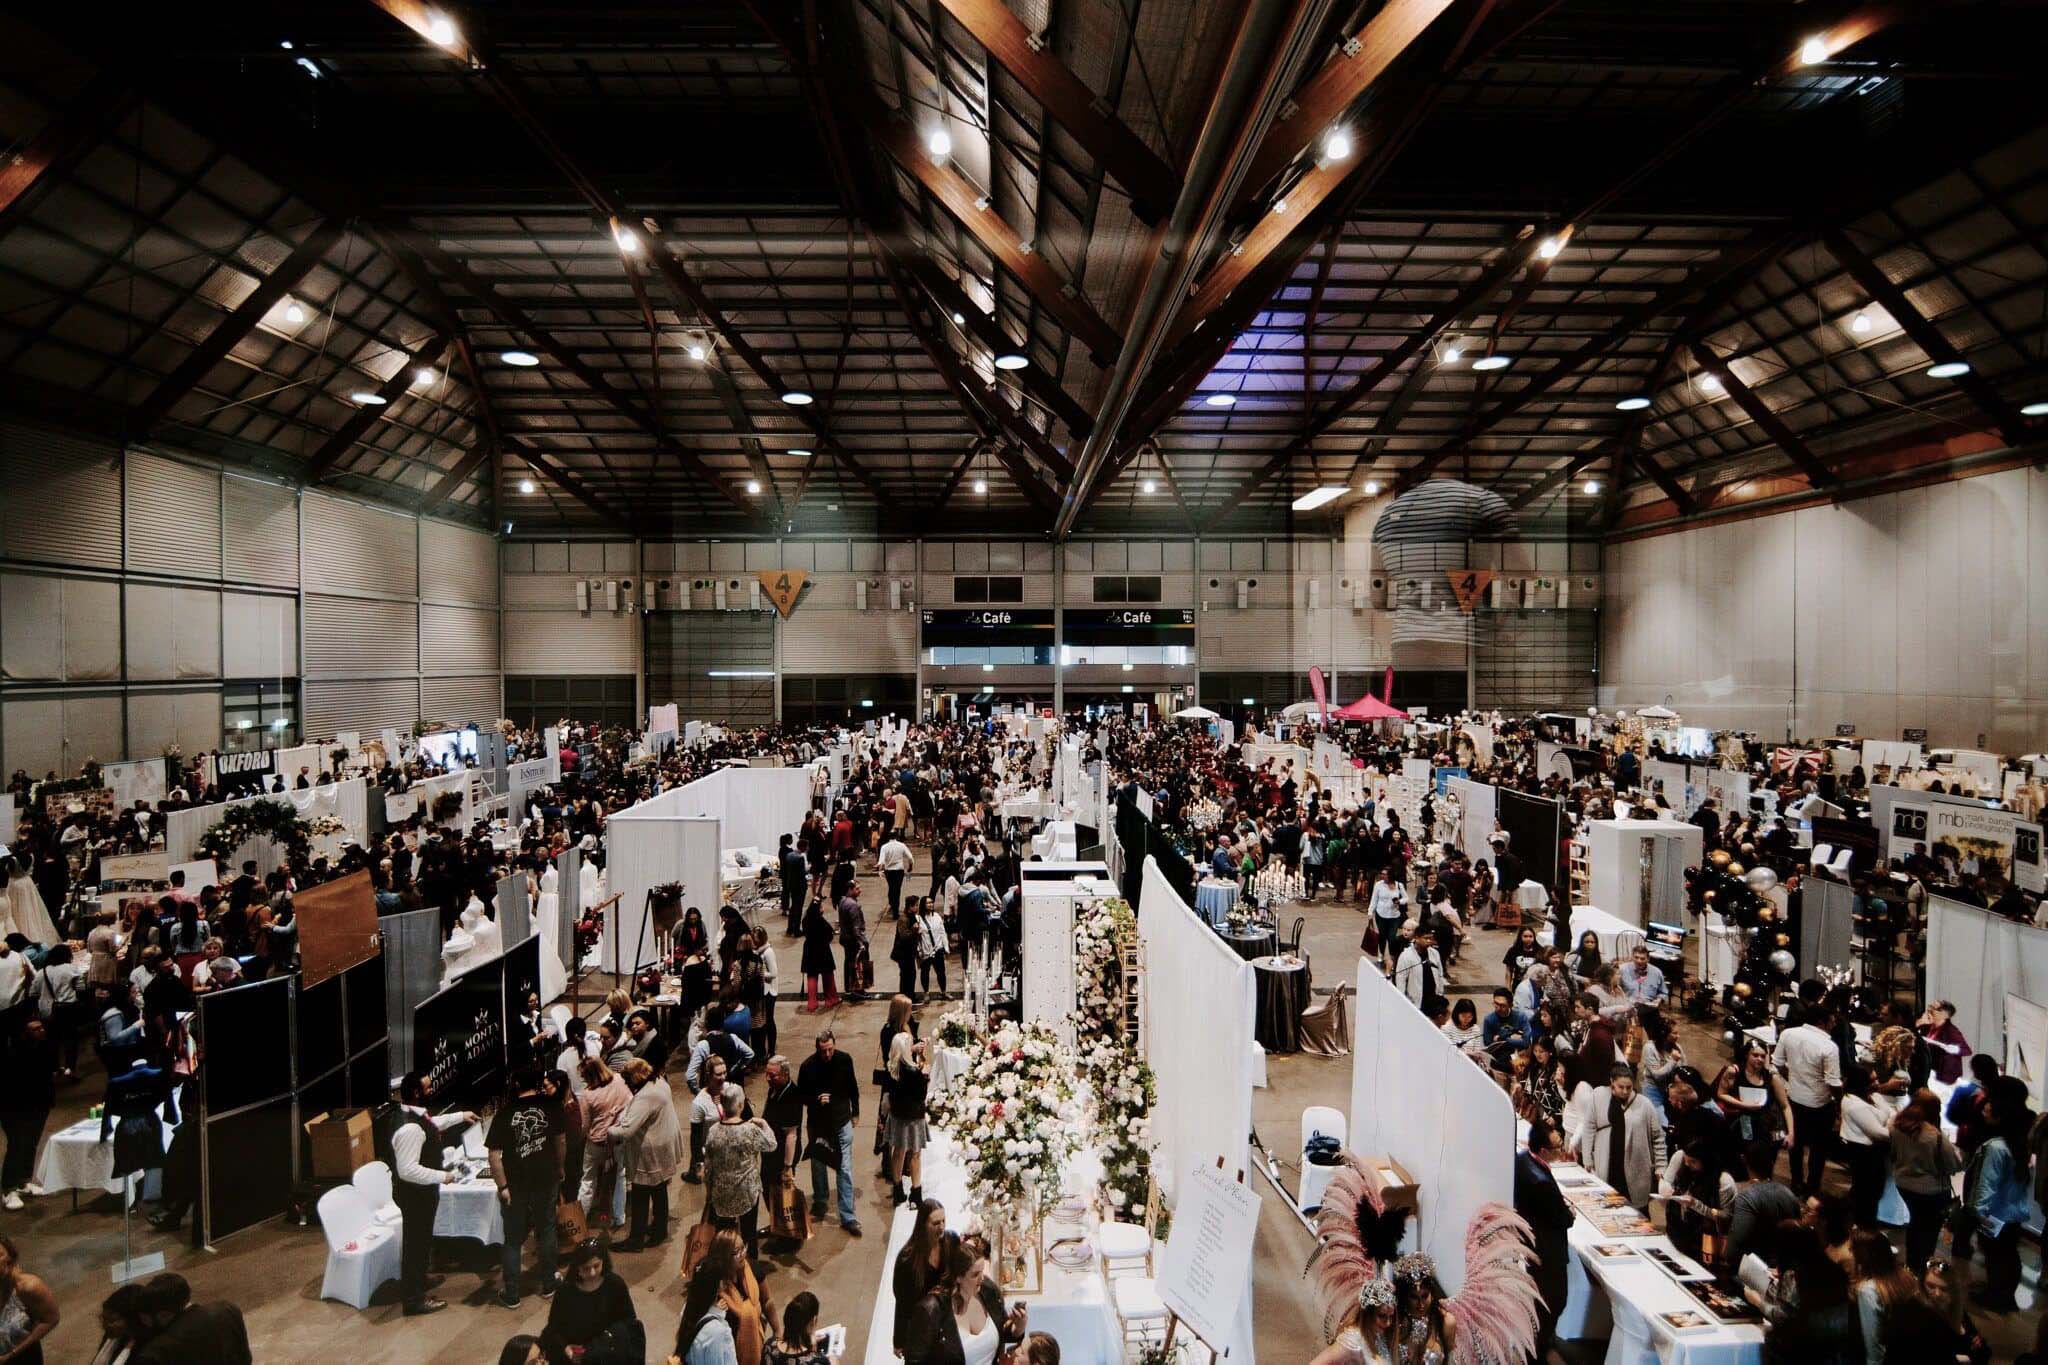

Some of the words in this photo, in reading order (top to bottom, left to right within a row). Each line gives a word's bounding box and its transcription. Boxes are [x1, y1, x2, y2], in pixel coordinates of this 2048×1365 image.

[776, 574, 791, 592] 4
[1461, 573, 1477, 592] 4
[982, 612, 1012, 624] Café
[1122, 611, 1152, 623] Café
[218, 750, 270, 774] OXFORD
[1894, 809, 1927, 830] mb
[1938, 811, 1964, 828] mb
[464, 1021, 499, 1051] MONTY
